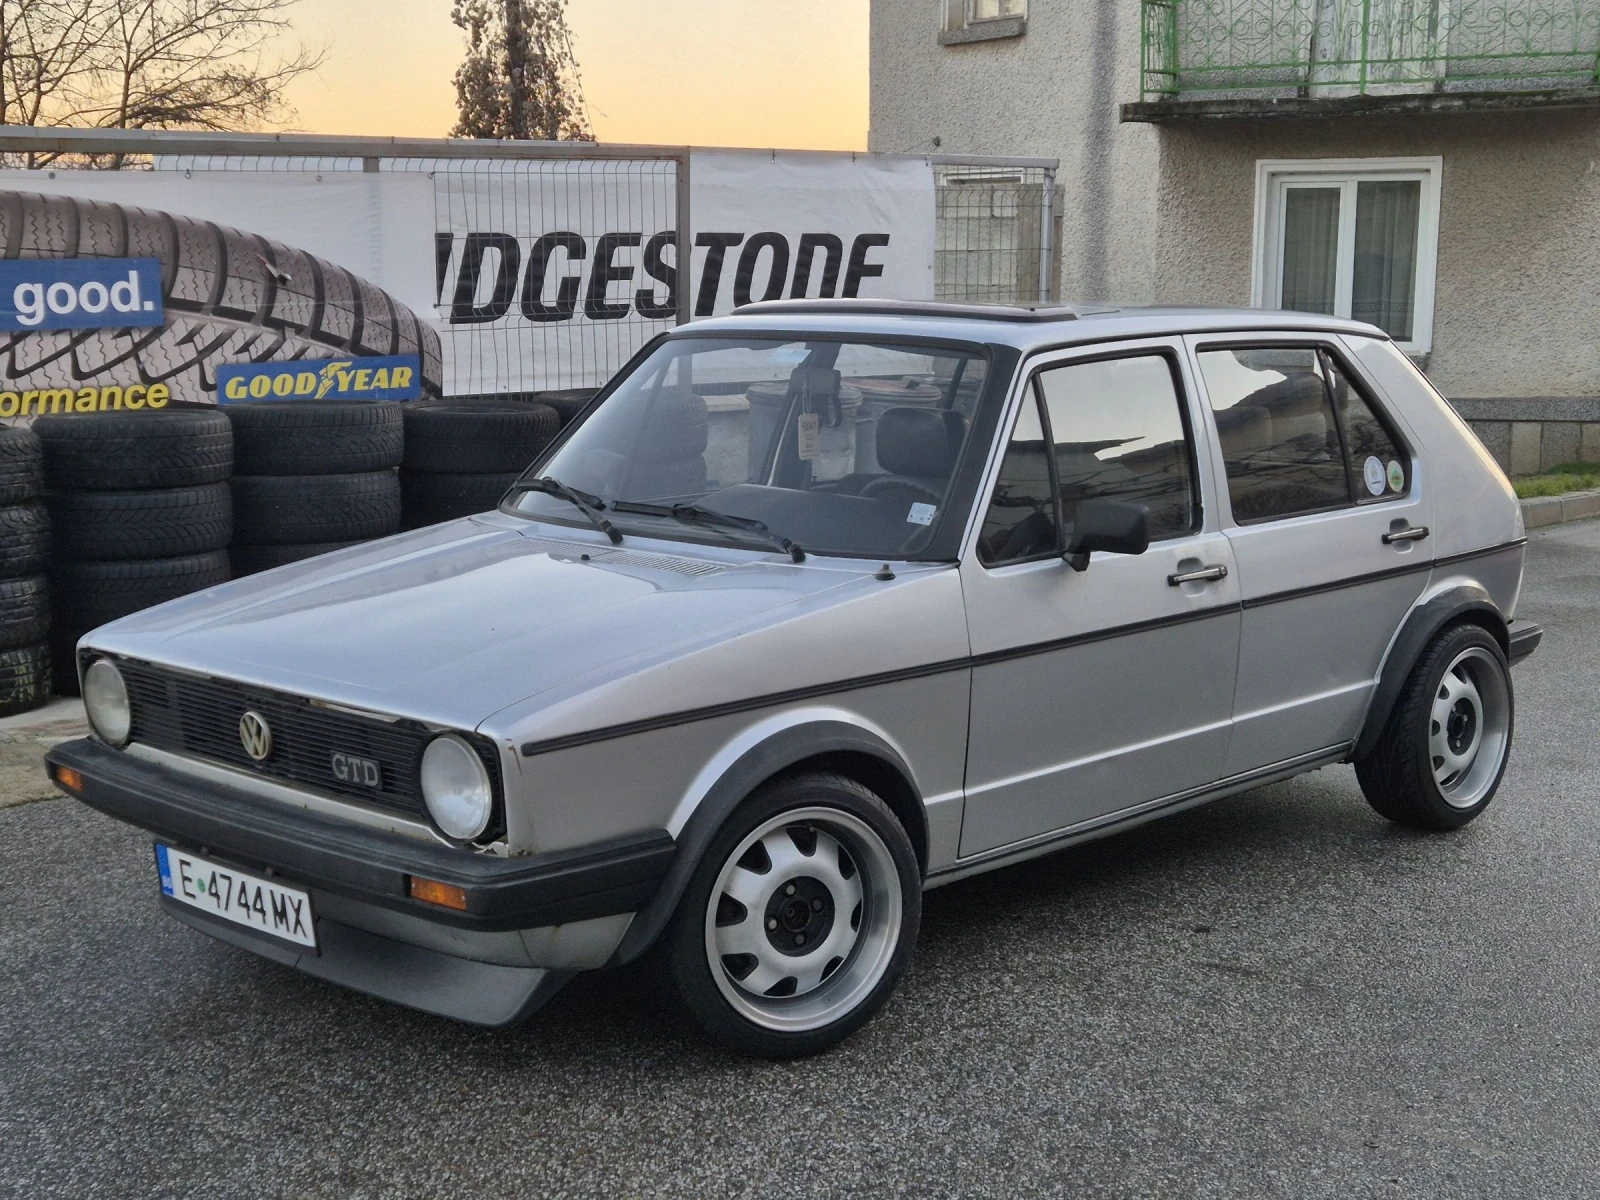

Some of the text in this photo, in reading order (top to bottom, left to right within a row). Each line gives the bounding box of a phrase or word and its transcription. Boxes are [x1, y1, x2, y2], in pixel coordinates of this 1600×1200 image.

[13, 270, 154, 326] good.
[0, 383, 169, 418] ormance
[332, 753, 379, 787] GTD
